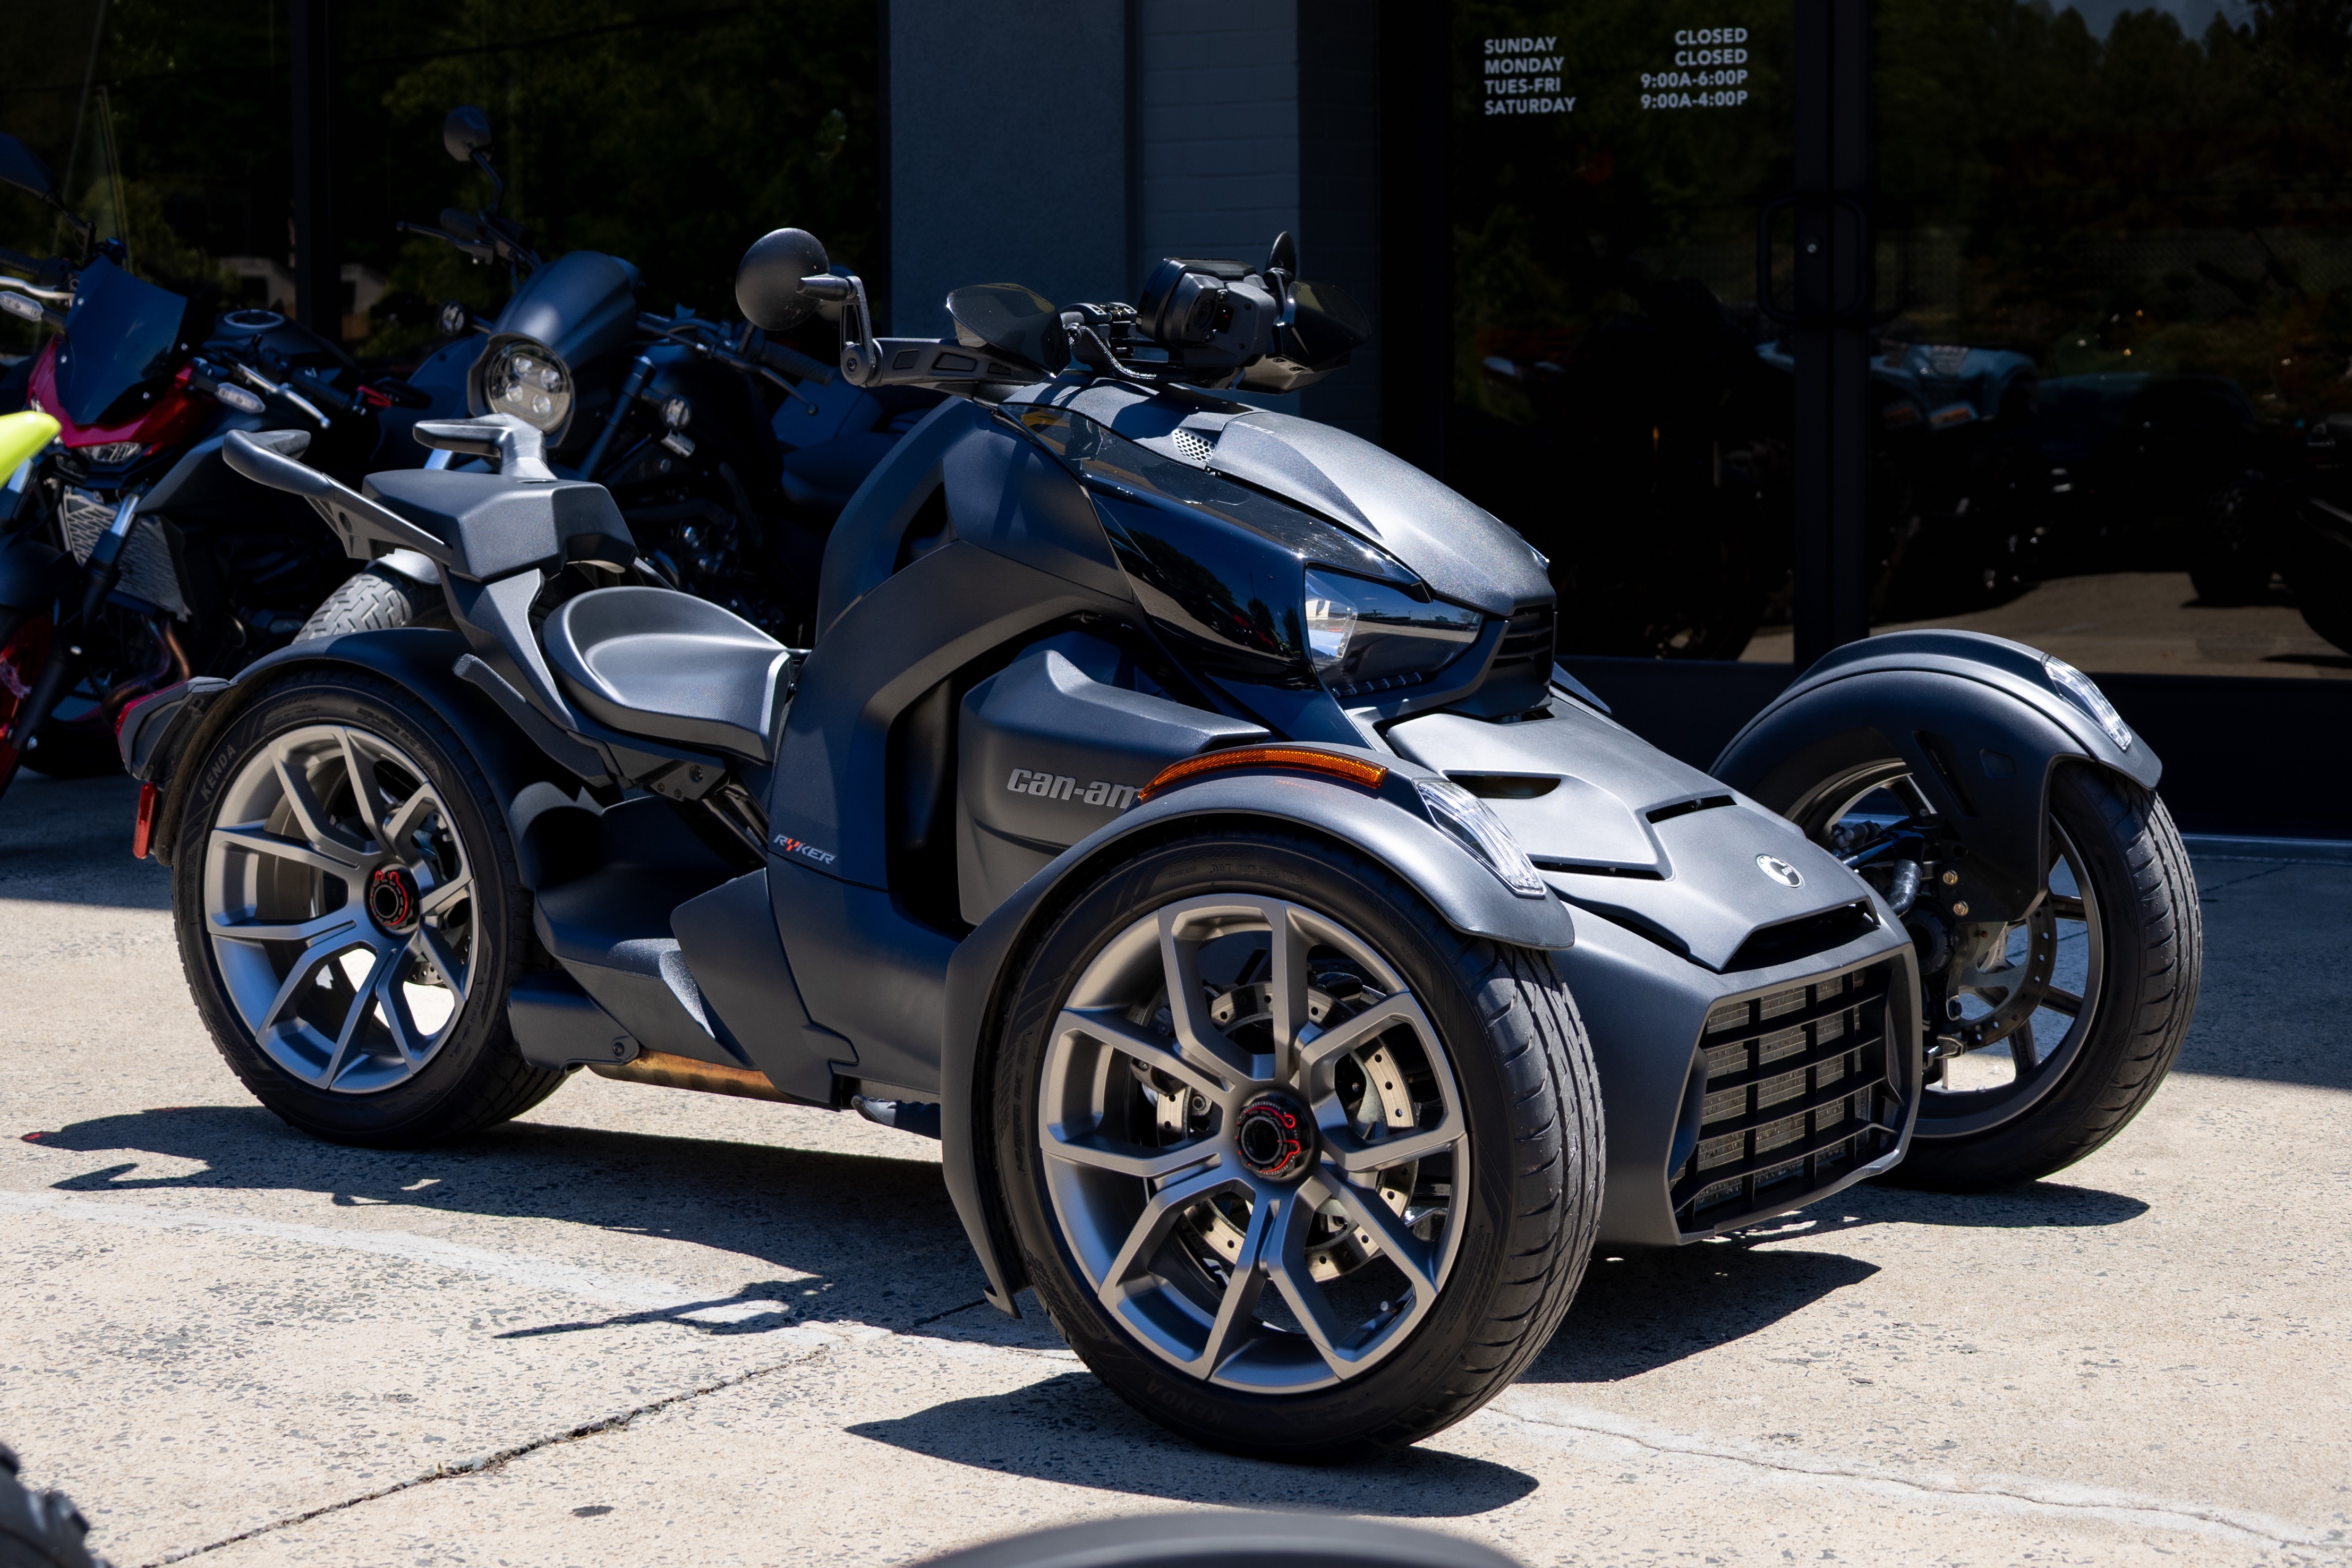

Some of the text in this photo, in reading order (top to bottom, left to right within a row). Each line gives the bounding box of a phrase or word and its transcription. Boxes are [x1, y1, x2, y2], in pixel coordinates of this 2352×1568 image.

[1485, 28, 1748, 54] SUNDAY CLOSED
[1485, 49, 1748, 74] MONDAY CLOSED
[1485, 70, 1748, 94] TUES-FRI 9:00A-6:00P
[1485, 90, 1748, 114] SATURDAY 9:00A-4:00P
[200, 744, 236, 801] KENDA
[1007, 768, 1144, 809] can-am
[773, 833, 836, 864] RYKER
[1169, 866, 1197, 879] TUBELESS
[1146, 1378, 1226, 1425] KENDA
